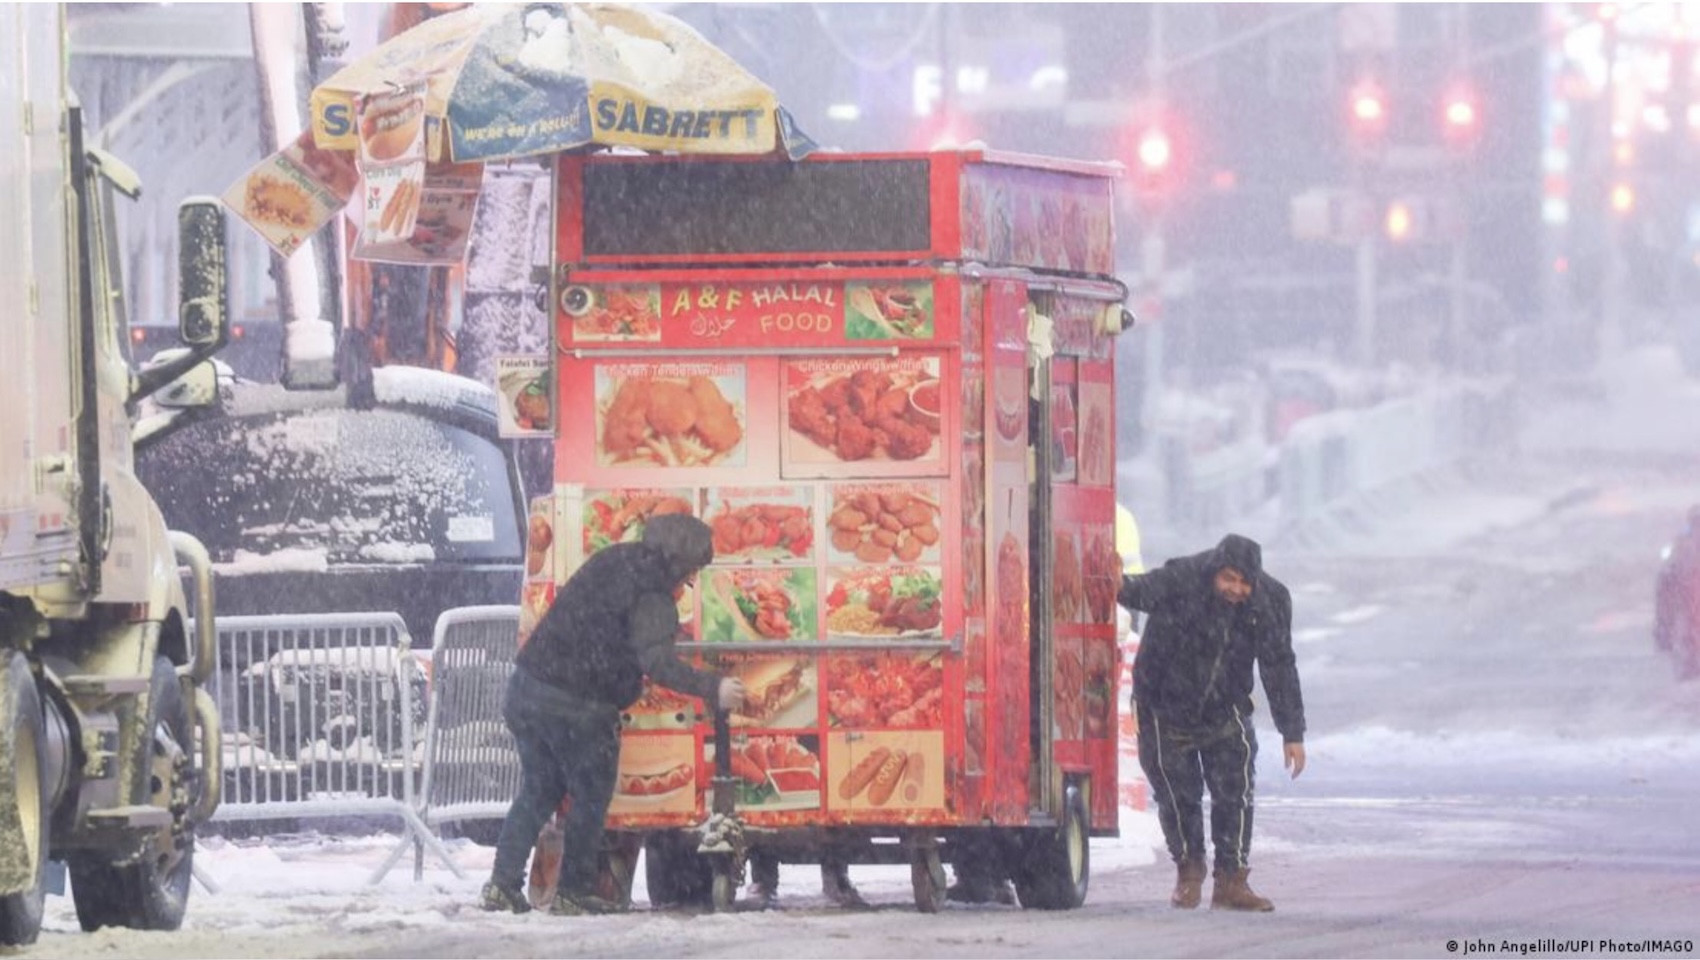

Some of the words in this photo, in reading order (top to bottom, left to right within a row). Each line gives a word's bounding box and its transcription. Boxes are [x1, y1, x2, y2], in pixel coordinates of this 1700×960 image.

[597, 98, 765, 139] SABRETT
[672, 285, 692, 316] A
[697, 284, 720, 309] &
[725, 288, 744, 312] F
[752, 282, 837, 309] HALAL
[760, 311, 833, 334] FOOD
[798, 357, 850, 372] Chicken
